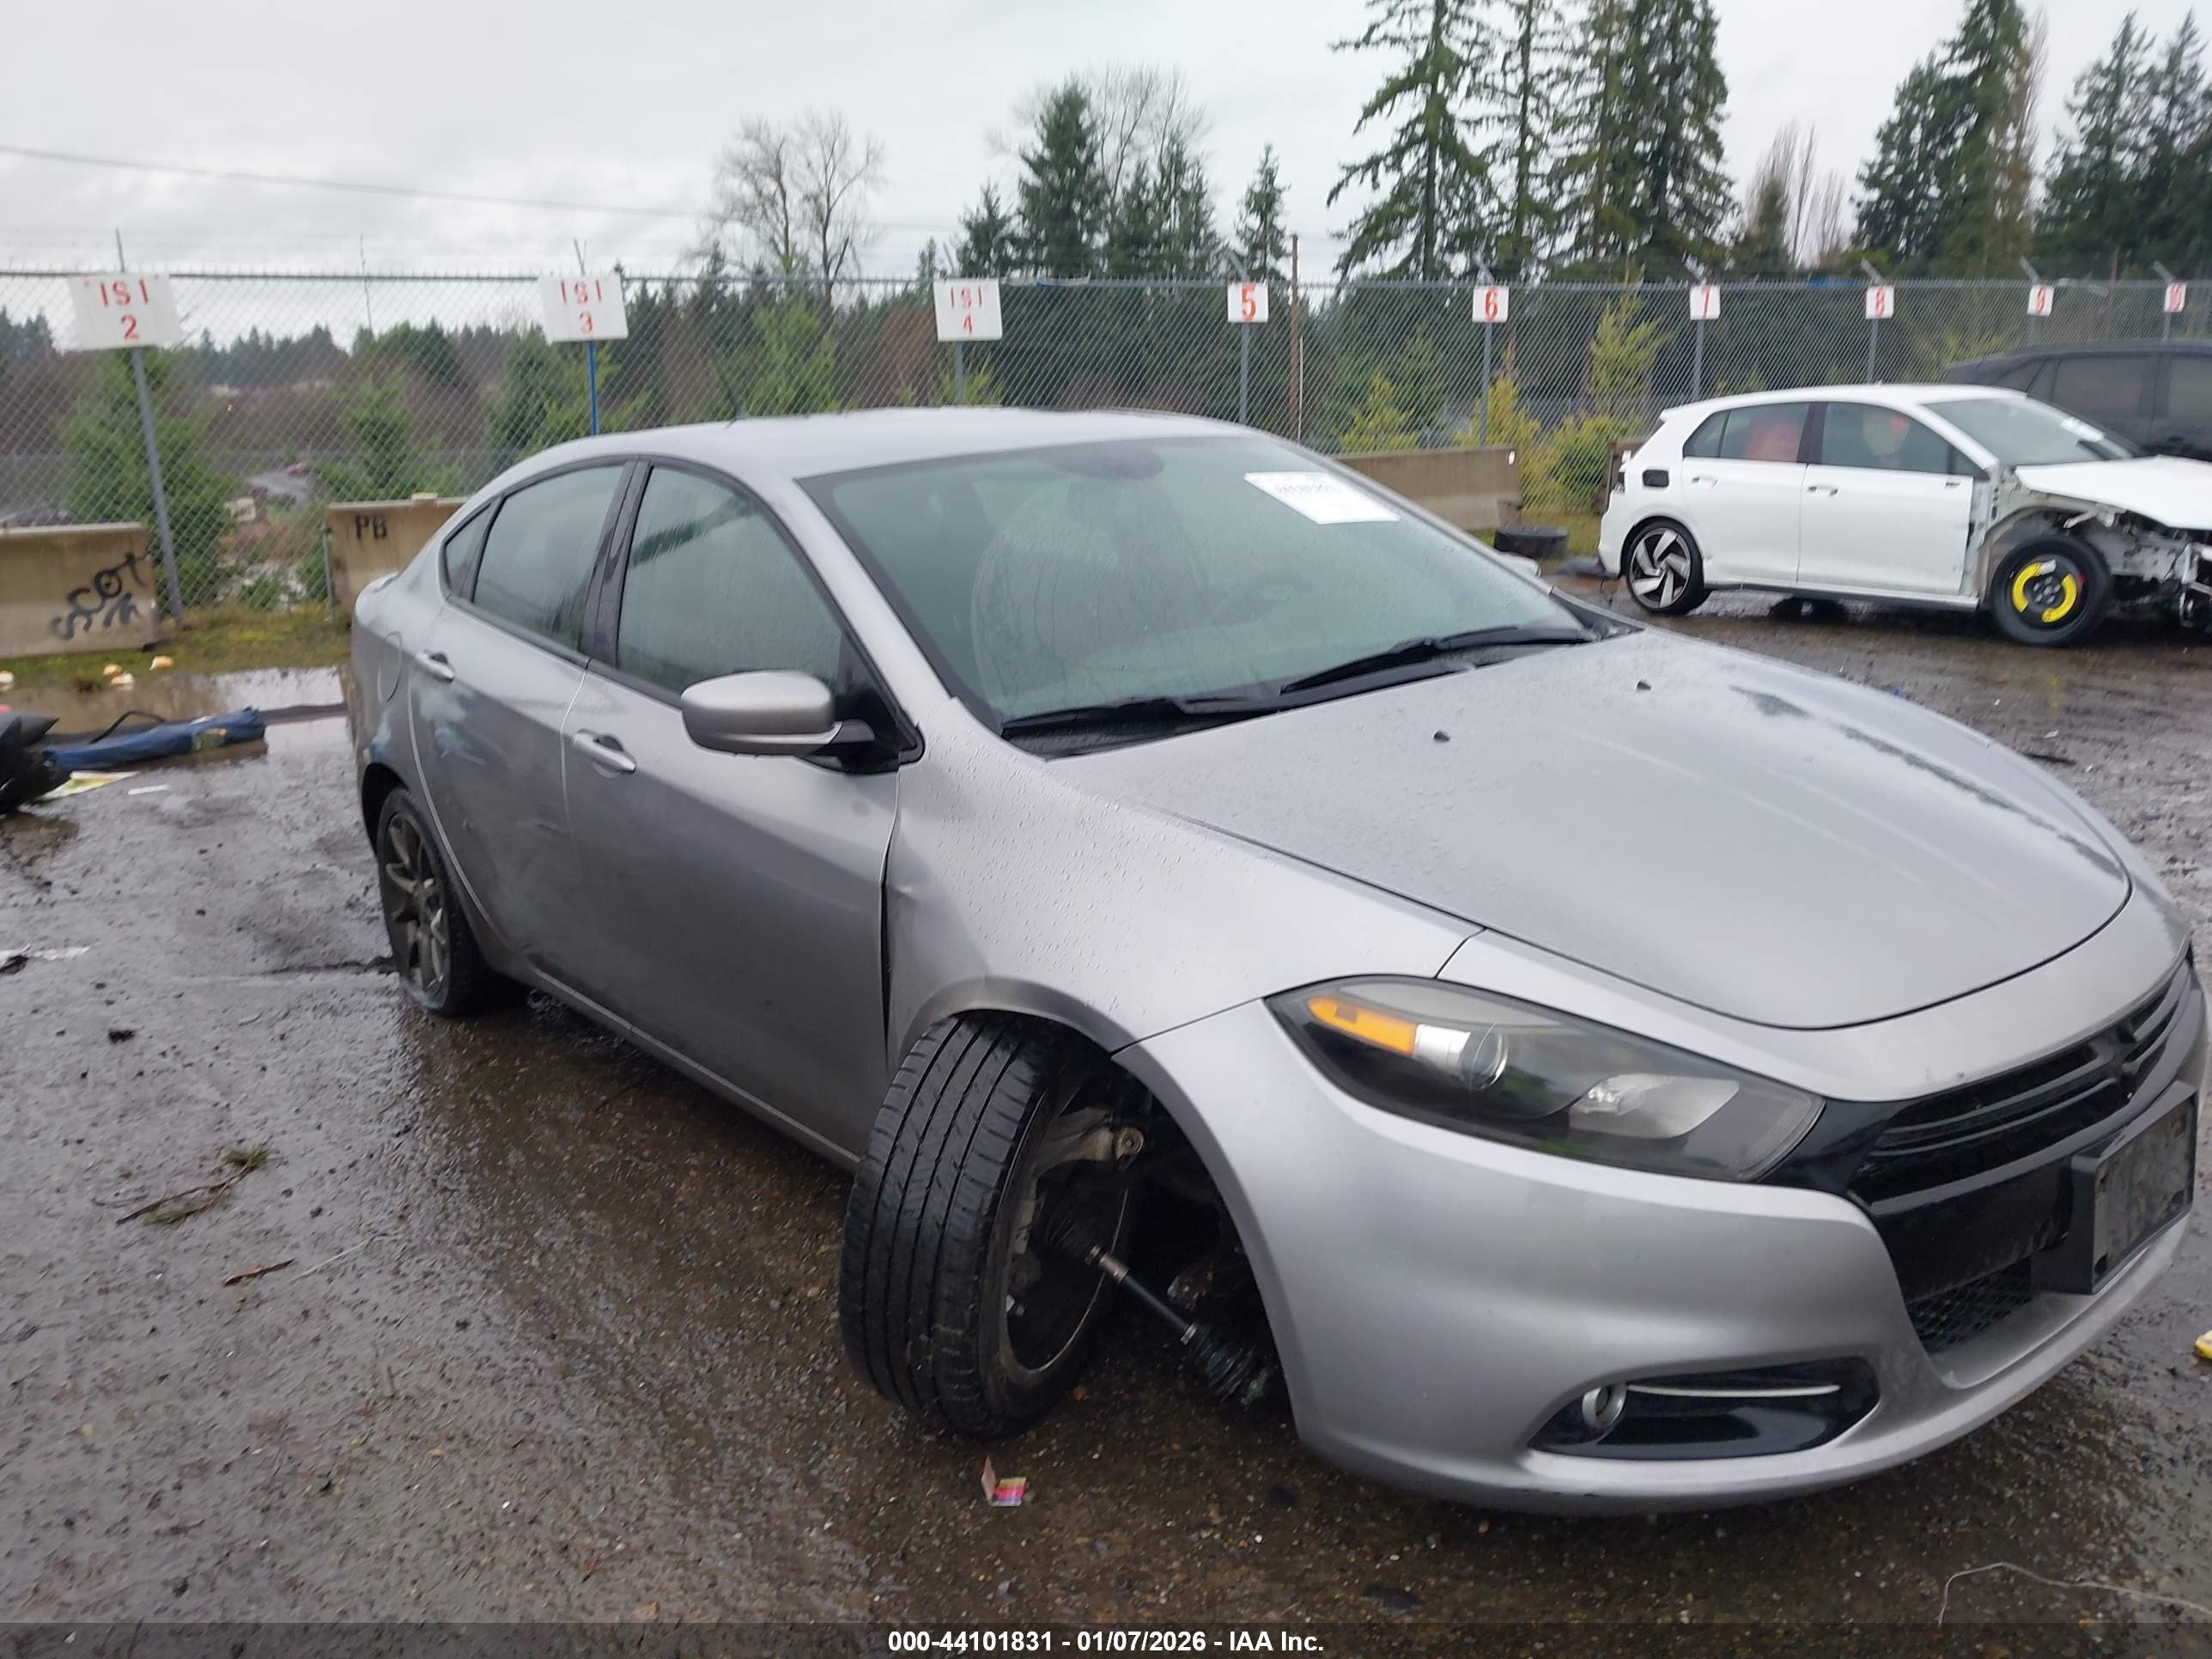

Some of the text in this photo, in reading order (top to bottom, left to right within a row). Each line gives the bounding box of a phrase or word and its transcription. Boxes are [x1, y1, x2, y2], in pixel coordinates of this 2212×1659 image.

[1241, 283, 1256, 321] 5
[1485, 287, 1498, 320] 6
[1699, 287, 1713, 316] 7
[1875, 288, 1886, 316] 8
[121, 314, 139, 340] 2
[580, 311, 593, 334] 3
[963, 314, 973, 334] 4
[356, 514, 387, 540] PB
